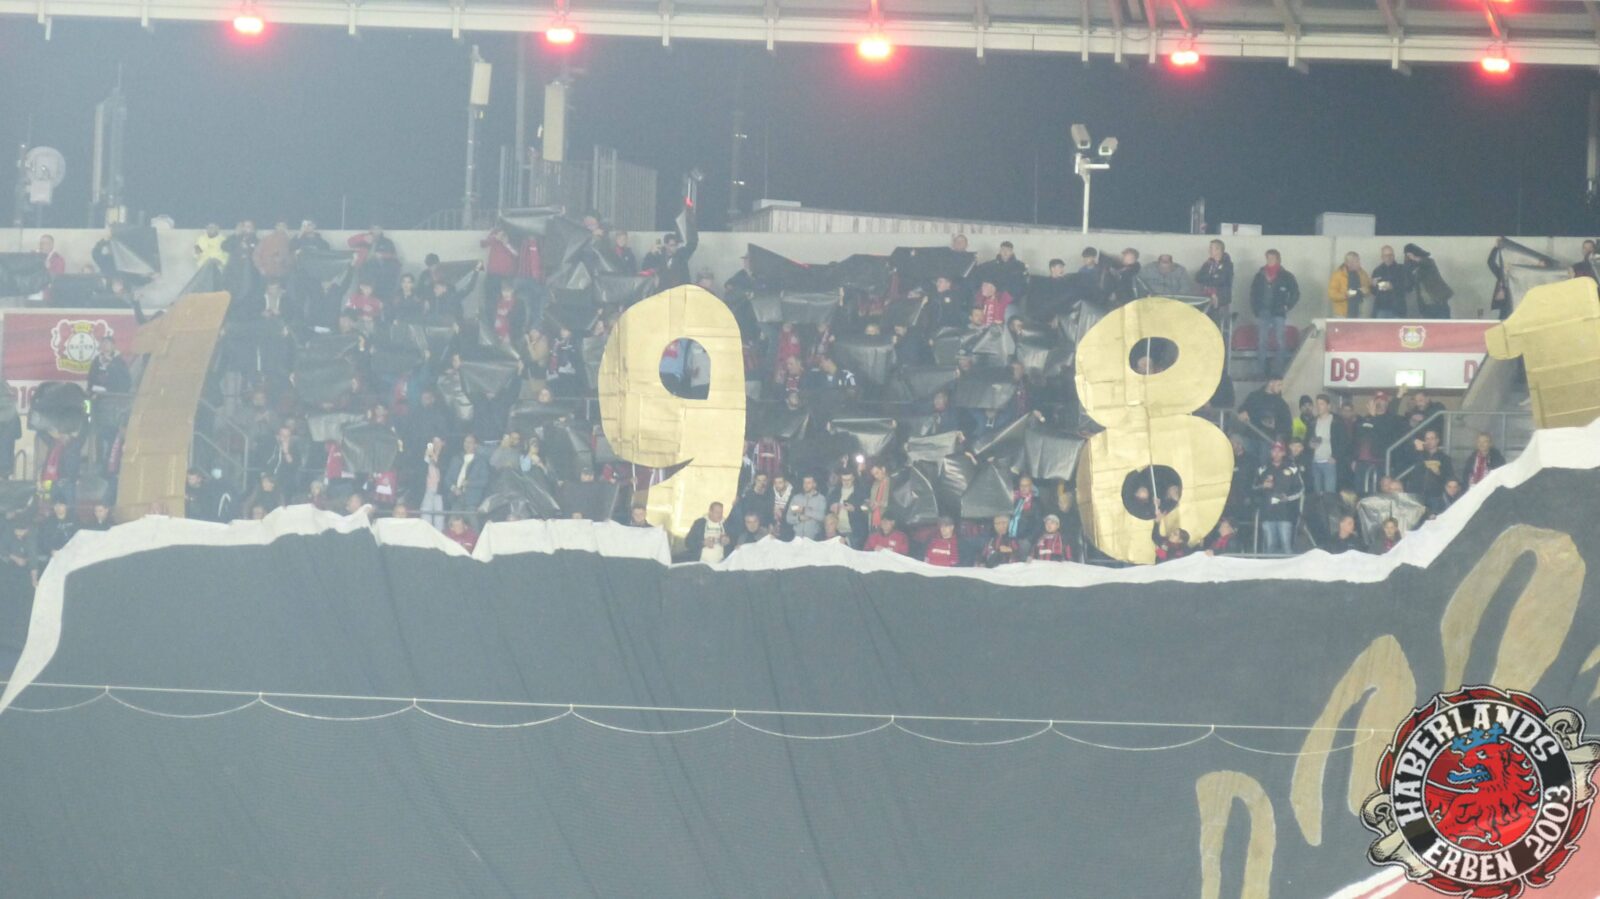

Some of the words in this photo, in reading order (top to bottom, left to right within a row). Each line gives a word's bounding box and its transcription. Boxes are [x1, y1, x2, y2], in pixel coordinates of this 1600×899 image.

[1330, 357, 1360, 382] D9
[1463, 359, 1479, 383] D
[598, 284, 746, 539] 9
[1075, 297, 1234, 564] 8
